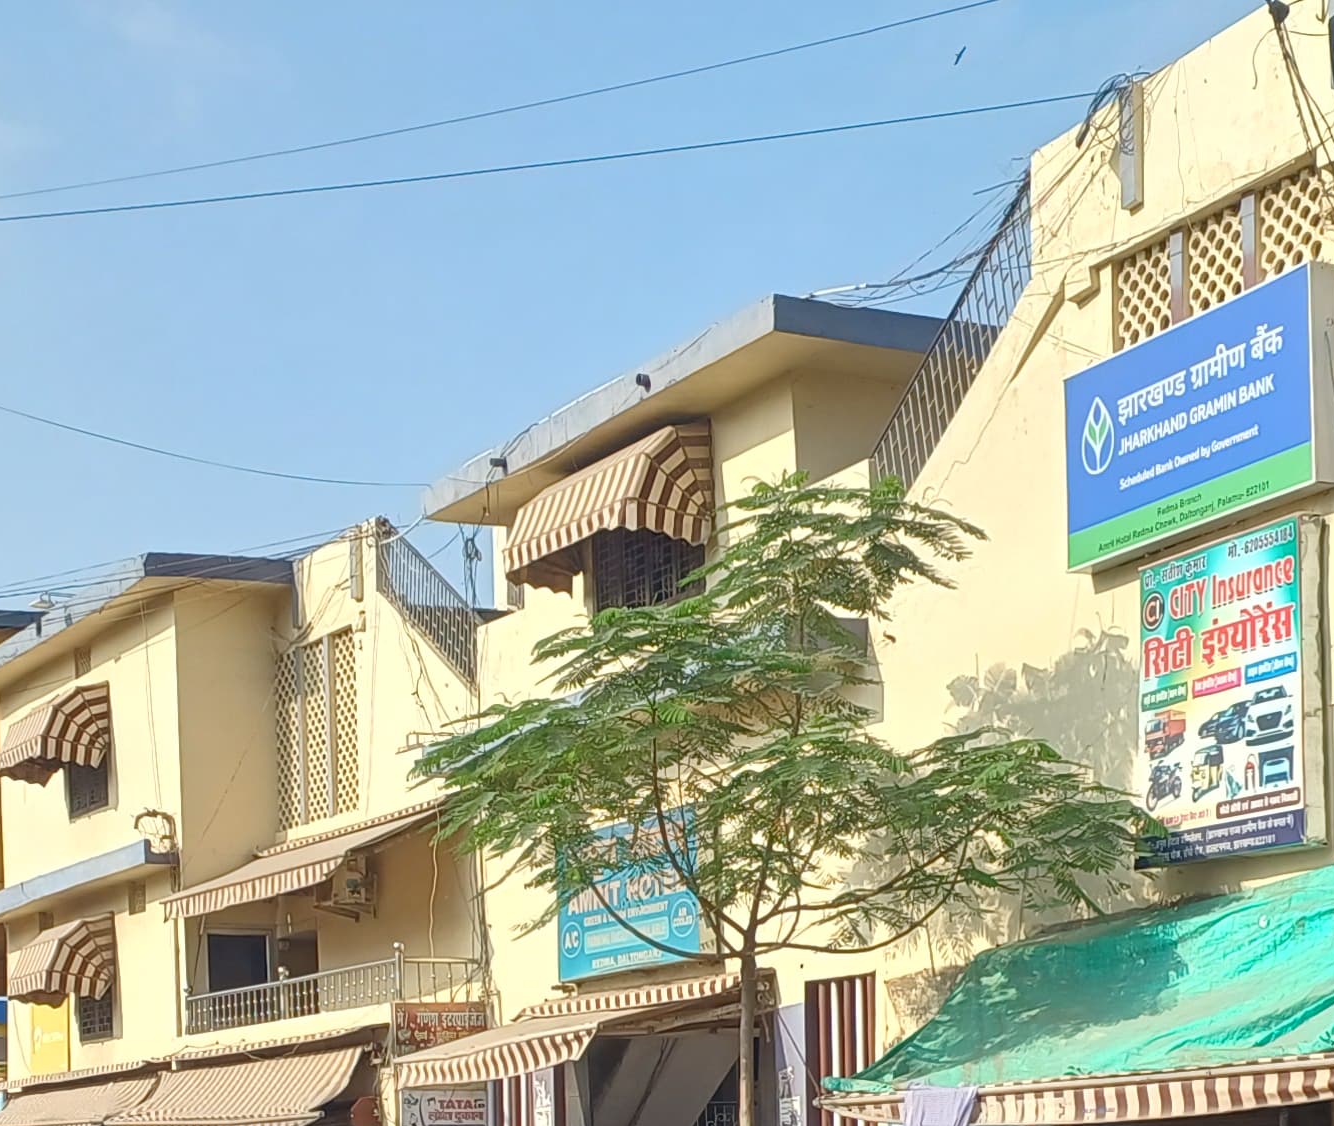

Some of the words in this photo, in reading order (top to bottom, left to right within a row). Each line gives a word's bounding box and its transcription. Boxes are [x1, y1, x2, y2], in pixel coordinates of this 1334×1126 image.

[1117, 369, 1187, 427] झारखण्ड
[1189, 343, 1246, 391] ग्रामीण
[1250, 323, 1284, 362] बैंक
[1118, 411, 1188, 456] JHARKHAND
[1189, 393, 1238, 425] GRAMIN
[1239, 373, 1276, 405] BANK
[1119, 466, 1156, 490] Scheduled
[1155, 458, 1174, 477] Bank
[1201, 445, 1211, 458] by
[1211, 424, 1260, 452] Government
[1211, 555, 1295, 608] Insurance
[1143, 625, 1195, 679] सिटी
